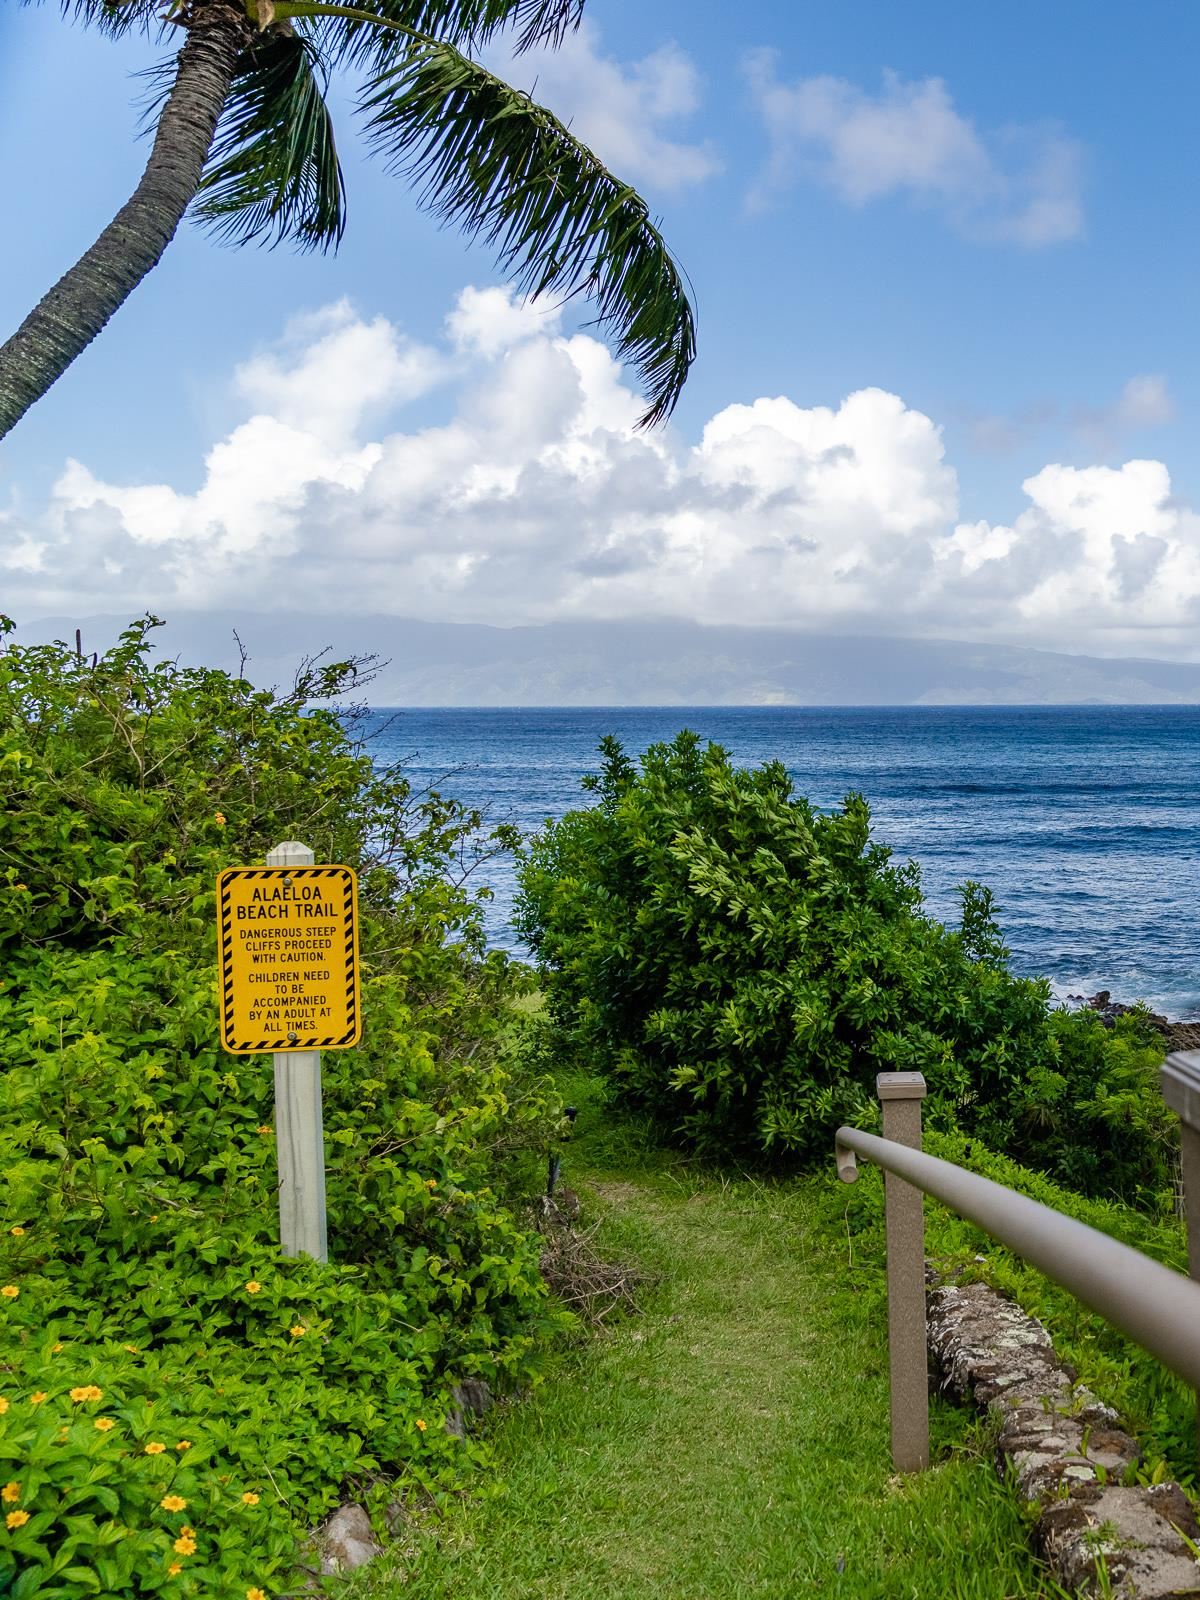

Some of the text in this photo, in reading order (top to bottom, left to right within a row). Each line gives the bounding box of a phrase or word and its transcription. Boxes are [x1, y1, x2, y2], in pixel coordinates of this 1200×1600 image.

[252, 886, 322, 902] ALAELOA
[237, 903, 338, 920] BEACH TRAIL
[239, 926, 337, 939] DANGEROUS STEEP
[245, 940, 332, 952] CLIFFS PROCEED
[252, 952, 326, 964] WITH CAUTION.
[248, 971, 330, 983] CHILDREN NEED
[275, 984, 305, 994] TO BE
[253, 996, 327, 1008] ACCOMPANIED
[249, 1007, 332, 1021] BY AN ADULT AT
[263, 1021, 318, 1033] ALL TIMES.
